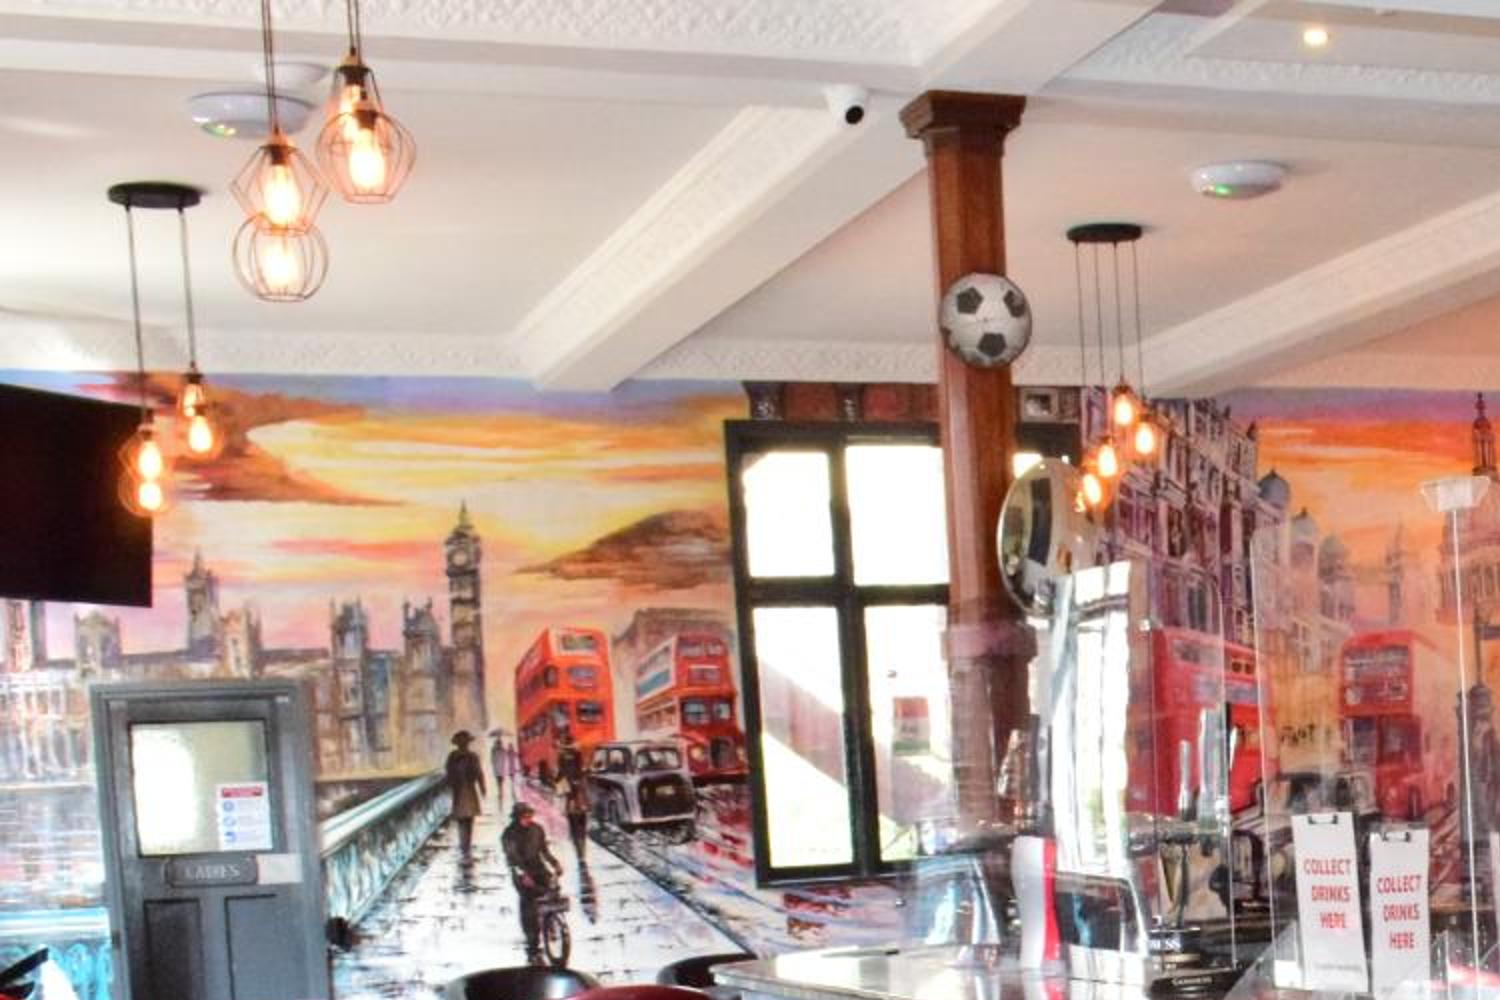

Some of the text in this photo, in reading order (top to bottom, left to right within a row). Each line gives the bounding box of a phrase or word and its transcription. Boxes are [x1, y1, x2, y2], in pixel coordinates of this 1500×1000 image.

[185, 864, 241, 879] LADIES
[1303, 858, 1351, 876] COLLECT
[1377, 874, 1422, 894] COLLECT
[1311, 885, 1351, 902] DRINKS
[1320, 912, 1346, 929] HERE
[1383, 903, 1420, 922] DRINKS
[1390, 931, 1415, 949] HERE
